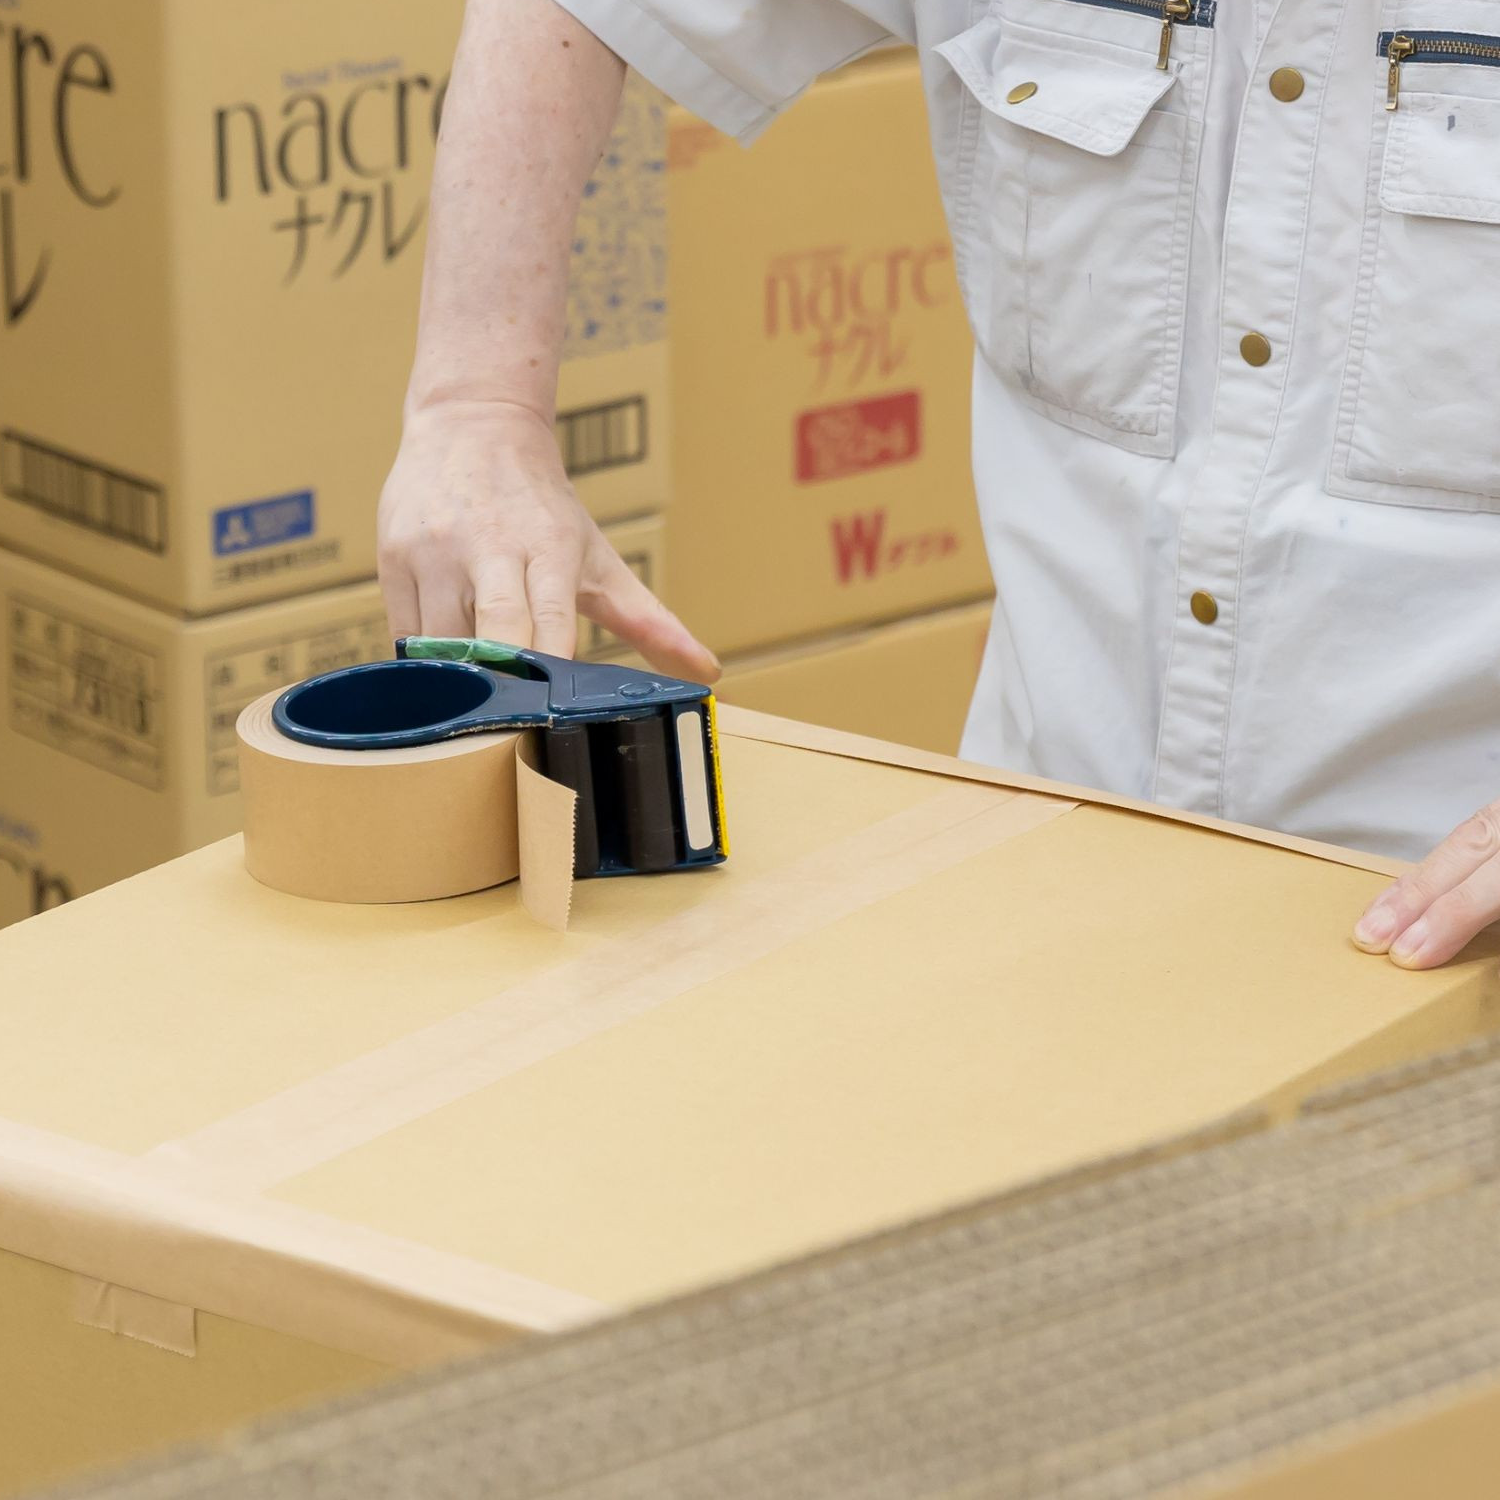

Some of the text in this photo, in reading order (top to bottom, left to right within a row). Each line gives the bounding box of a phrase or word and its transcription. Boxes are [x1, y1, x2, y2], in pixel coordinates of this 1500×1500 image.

[213, 67, 450, 205] nacr
[274, 180, 432, 288] ナクレ
[831, 507, 888, 587] W
